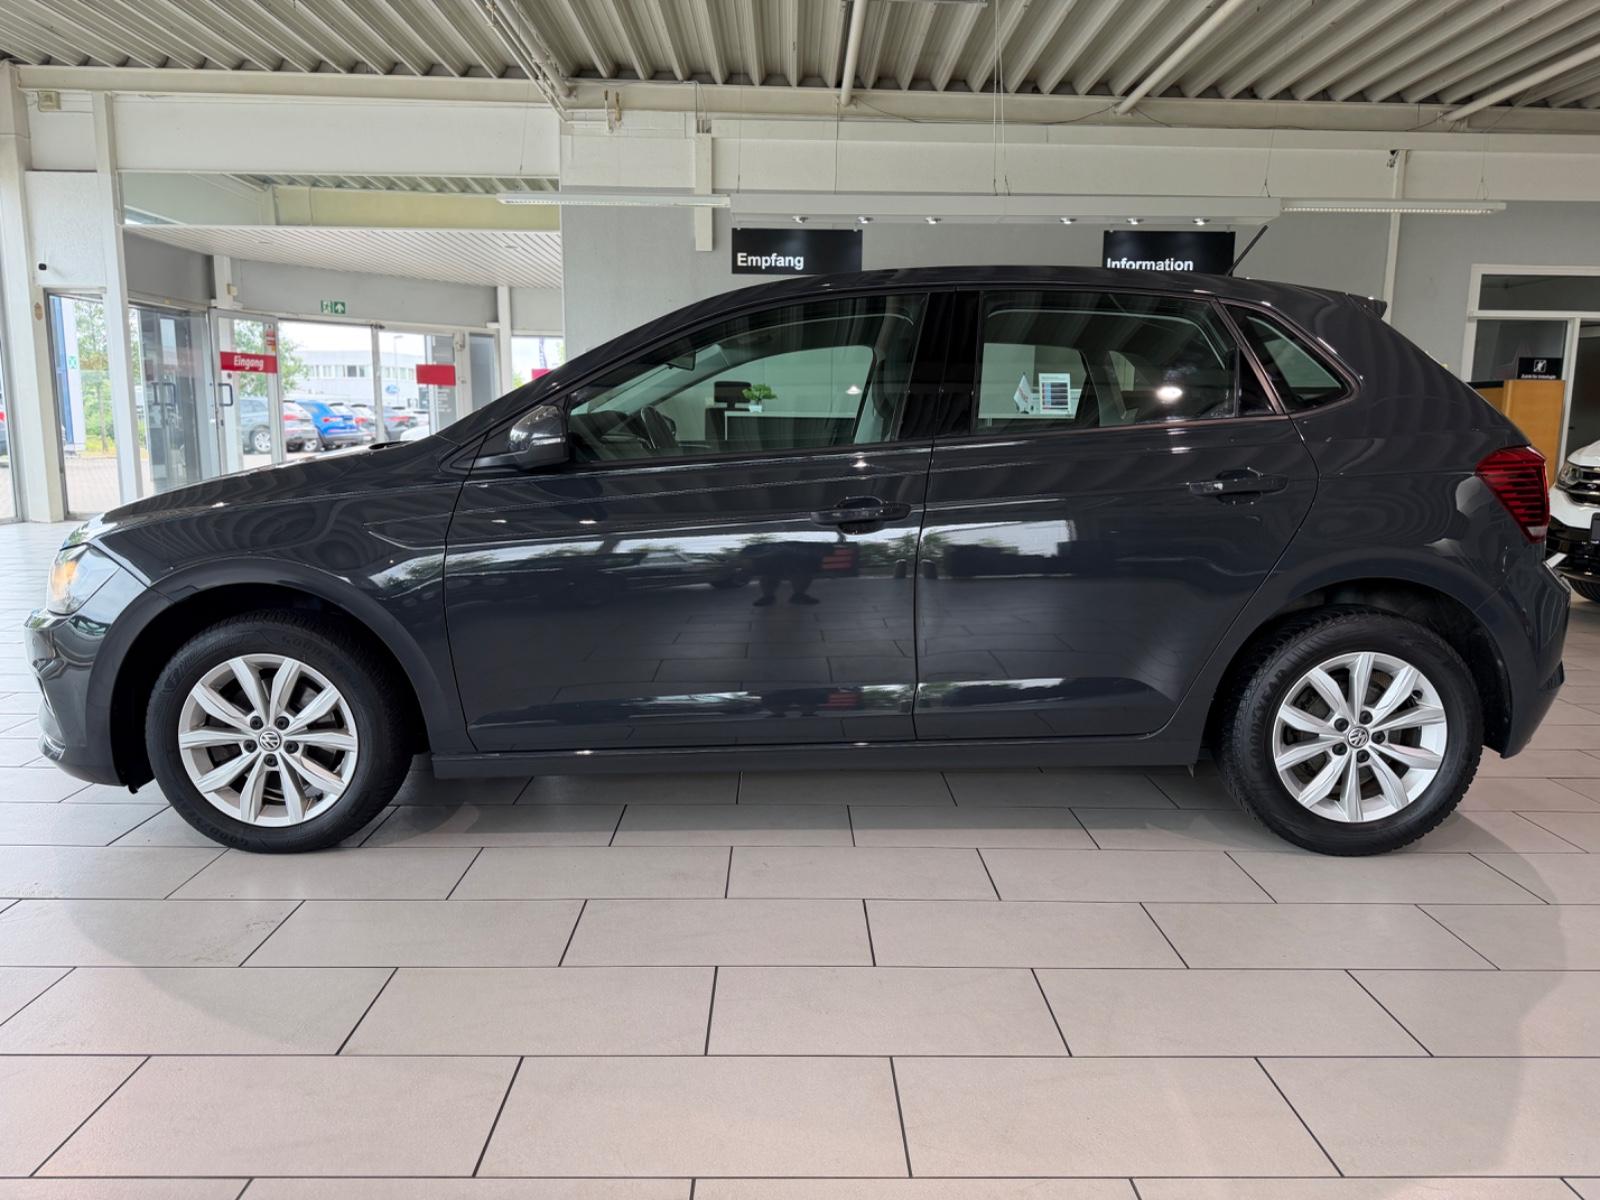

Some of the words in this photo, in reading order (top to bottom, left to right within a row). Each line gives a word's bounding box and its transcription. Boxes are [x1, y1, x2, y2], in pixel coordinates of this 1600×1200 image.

[737, 252, 804, 270] Empfang
[1106, 257, 1194, 271] Information
[233, 354, 264, 371] Eingang
